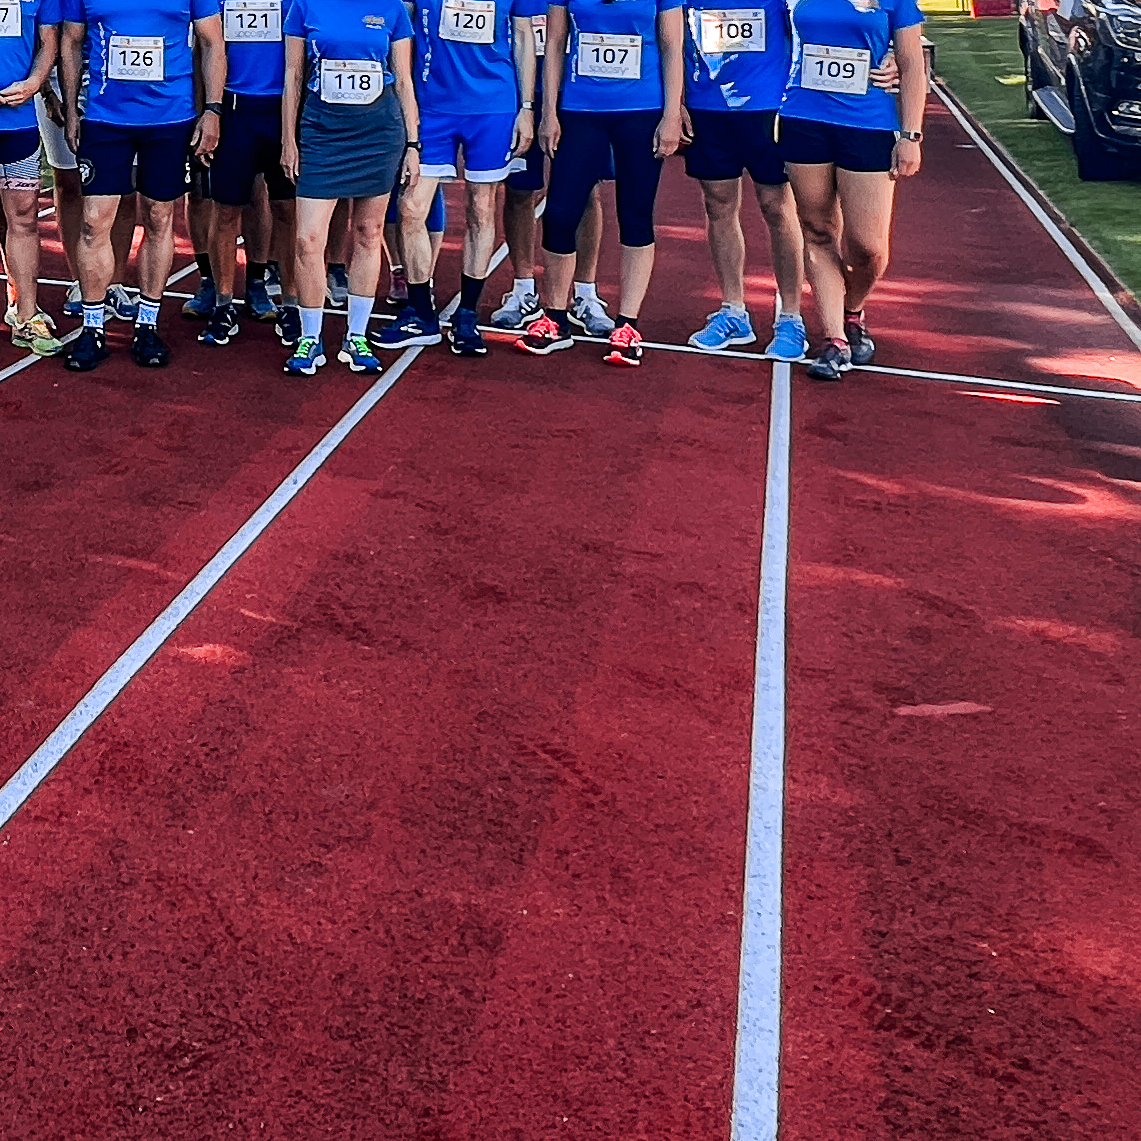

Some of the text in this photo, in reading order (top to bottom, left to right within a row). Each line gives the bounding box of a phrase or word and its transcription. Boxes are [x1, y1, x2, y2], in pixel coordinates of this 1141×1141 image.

[235, 13, 268, 29] 121
[452, 12, 486, 30] 120
[714, 23, 753, 39] 108
[118, 50, 154, 67] 126
[591, 47, 629, 64] 107
[814, 60, 856, 78] 109
[334, 73, 372, 91] 118
